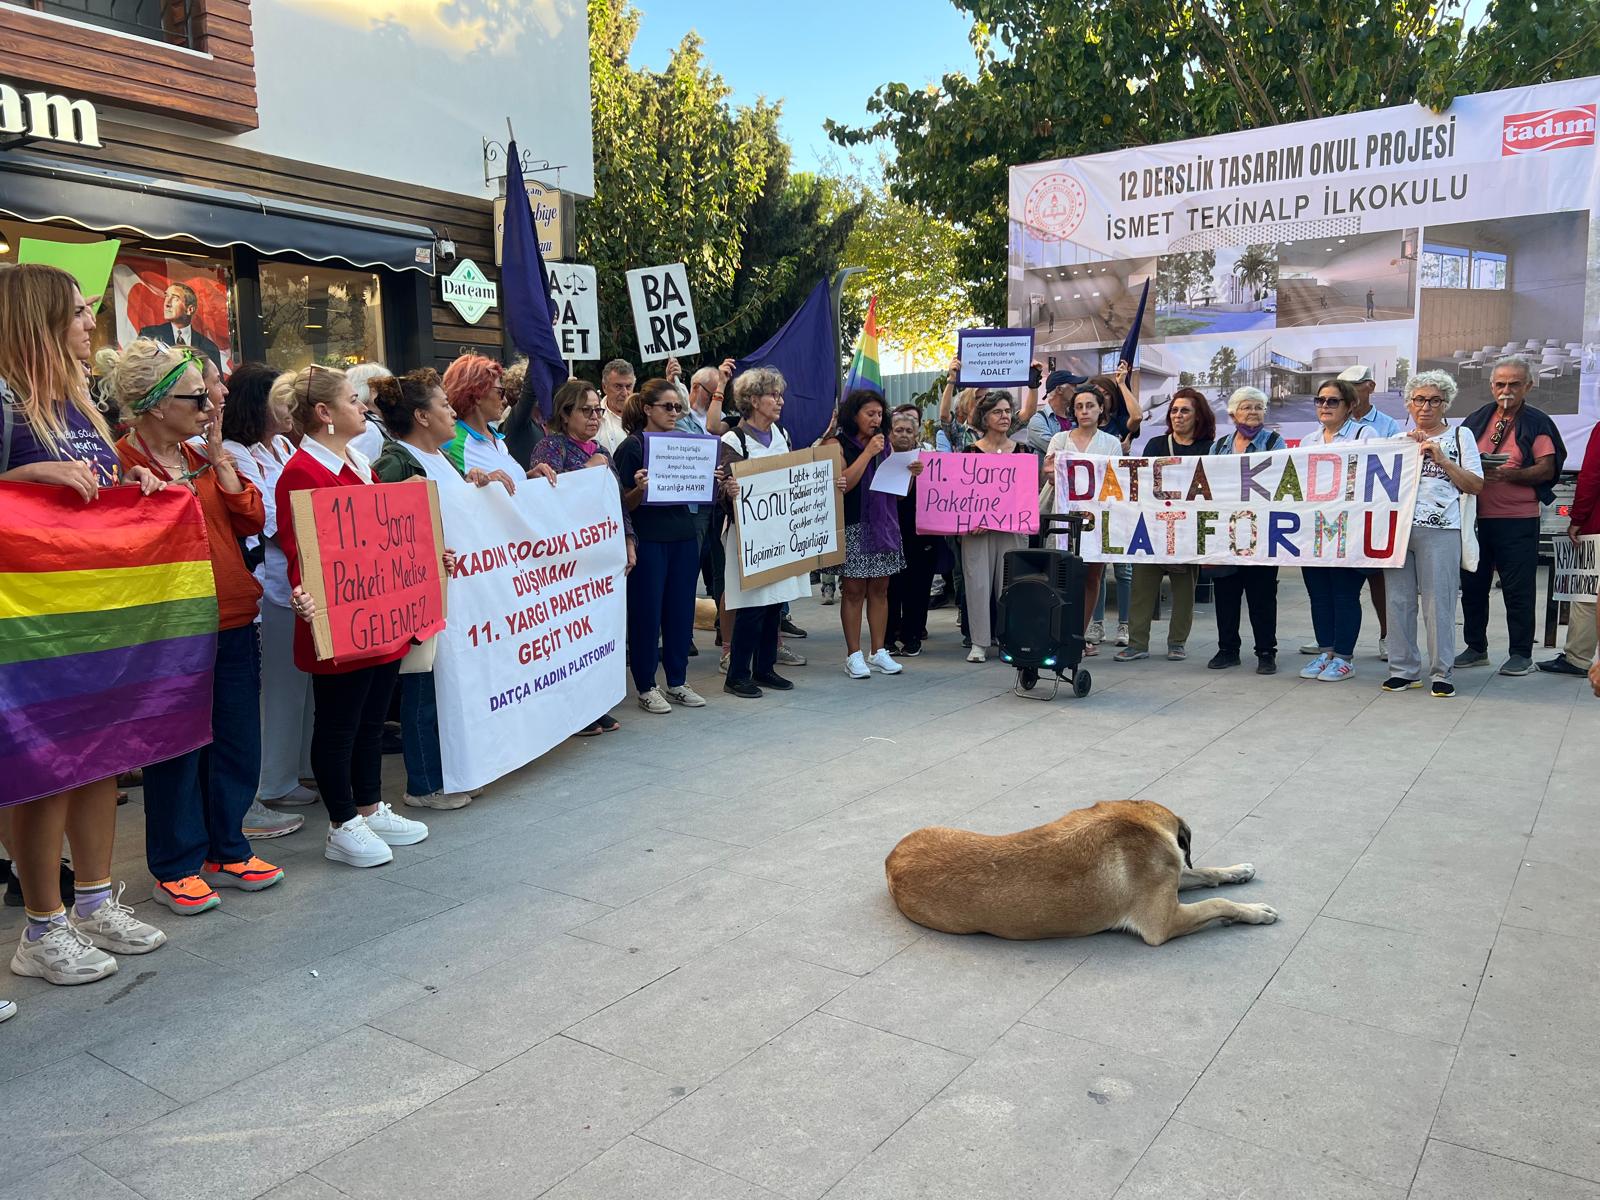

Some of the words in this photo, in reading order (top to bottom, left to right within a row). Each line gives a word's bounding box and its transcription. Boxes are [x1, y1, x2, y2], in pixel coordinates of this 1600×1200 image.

[1503, 117, 1595, 143] tadım
[1119, 170, 1138, 201] 12
[1143, 155, 1214, 198] DERSLİK
[1220, 145, 1304, 189] TASARIM
[1309, 137, 1359, 176] OKUL
[1366, 115, 1456, 168] PROJESİ
[1107, 212, 1174, 241] İSMET
[1186, 195, 1310, 231] TEKİNALP
[1324, 174, 1468, 216] İLKOKULU
[444, 280, 495, 299] Datçam
[641, 272, 686, 312] BA
[649, 311, 692, 353] RIŞ
[981, 368, 1011, 376] ADALET
[657, 484, 685, 492] Karanlığa
[685, 484, 705, 492] HAYIR
[927, 458, 947, 482] 11.
[960, 458, 1016, 493] Yargı
[1066, 456, 1213, 506] DATÇA
[1240, 453, 1403, 502] KADIN
[741, 484, 787, 525] Konu
[926, 488, 1000, 513] Paketine
[331, 496, 367, 549] 11.
[374, 492, 416, 560] Yargı
[956, 510, 1037, 534] HAYIR
[1068, 510, 1398, 559] PLATFORMU
[452, 545, 508, 579] KADIN
[508, 532, 570, 568] ÇOCUK
[571, 516, 619, 550] LGBTİ+
[744, 539, 786, 568] Hepimizin
[333, 559, 386, 606] Paketi
[392, 556, 428, 591] Meclise
[512, 560, 577, 598] DÜŞMANI
[467, 621, 500, 647] 11.
[505, 601, 550, 635] YARGI
[549, 575, 614, 617] PAKETİNE
[518, 627, 562, 665] GEÇİT
[564, 615, 594, 643] YOK
[489, 682, 531, 712] DATÇA
[534, 665, 567, 693] KADIN
[568, 639, 616, 676] PLATFORMU
